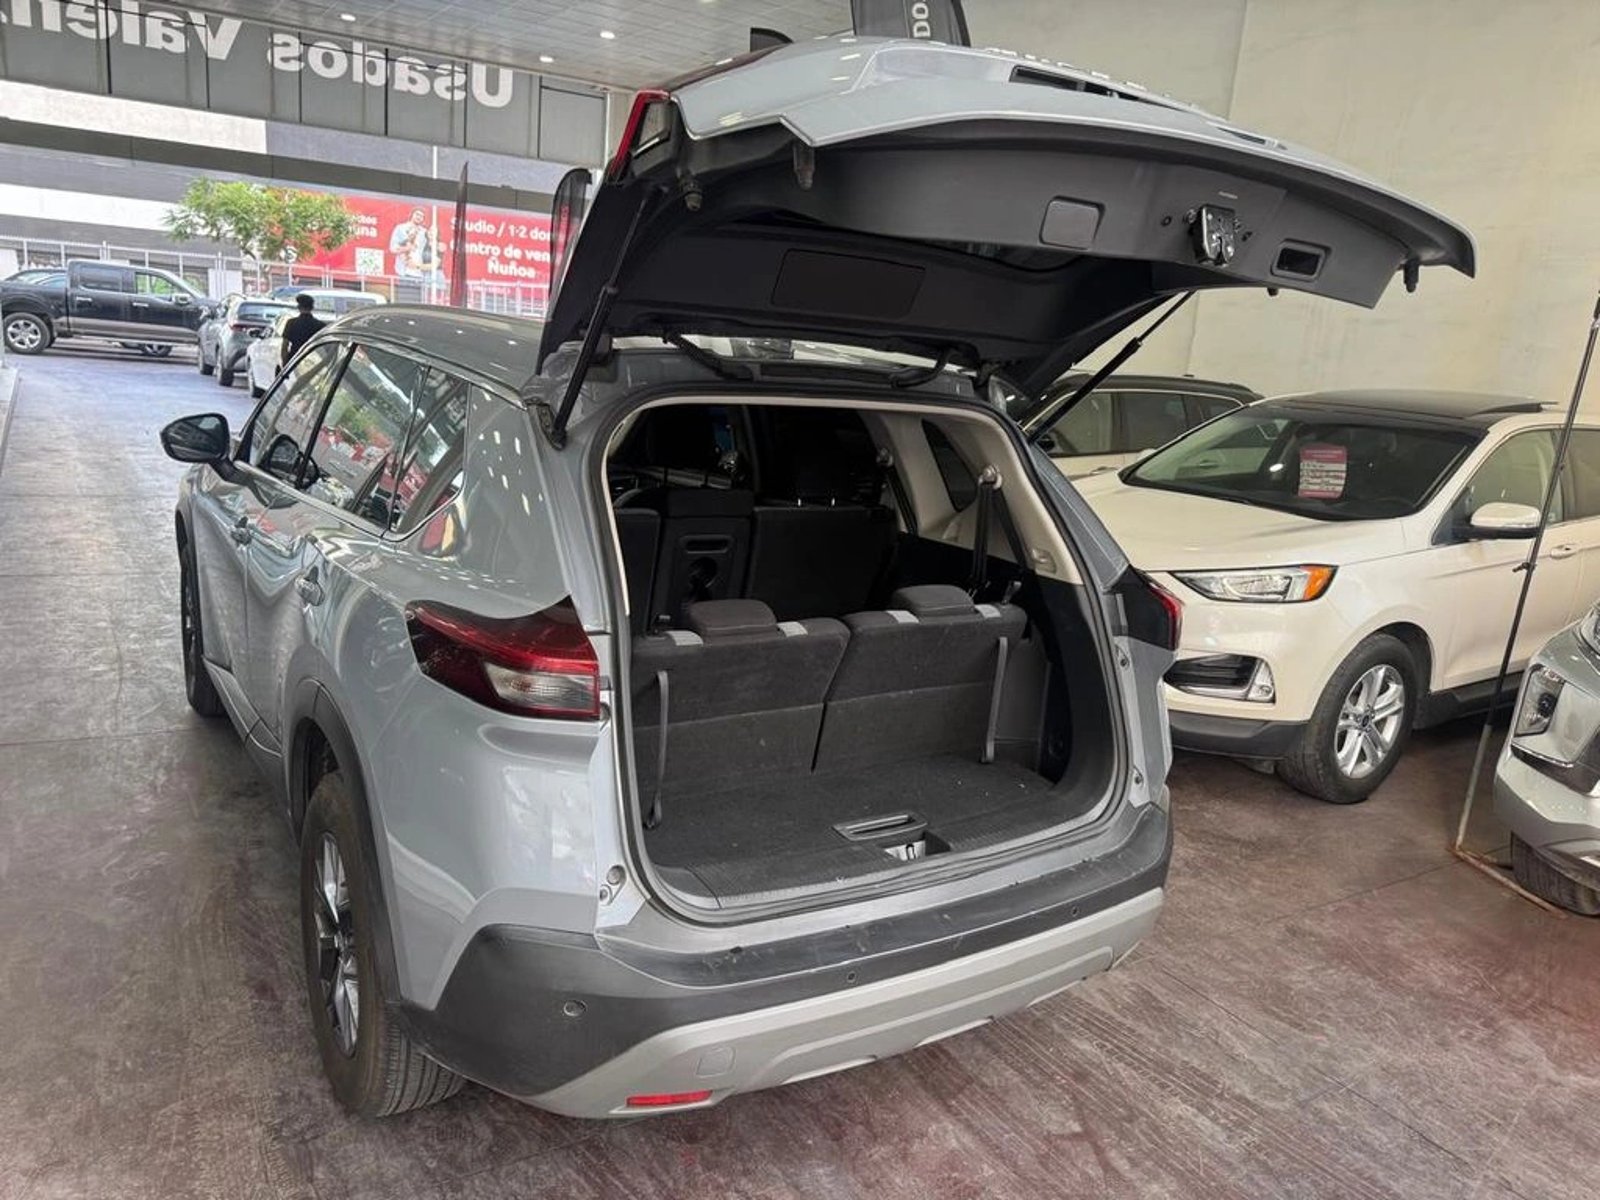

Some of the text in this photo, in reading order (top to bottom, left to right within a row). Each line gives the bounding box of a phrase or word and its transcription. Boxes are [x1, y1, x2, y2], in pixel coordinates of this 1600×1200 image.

[911, 0, 931, 38] DO
[450, 216, 496, 234] Sudio
[449, 239, 551, 262] Cntro de ven
[487, 255, 536, 279] Ñuñoa
